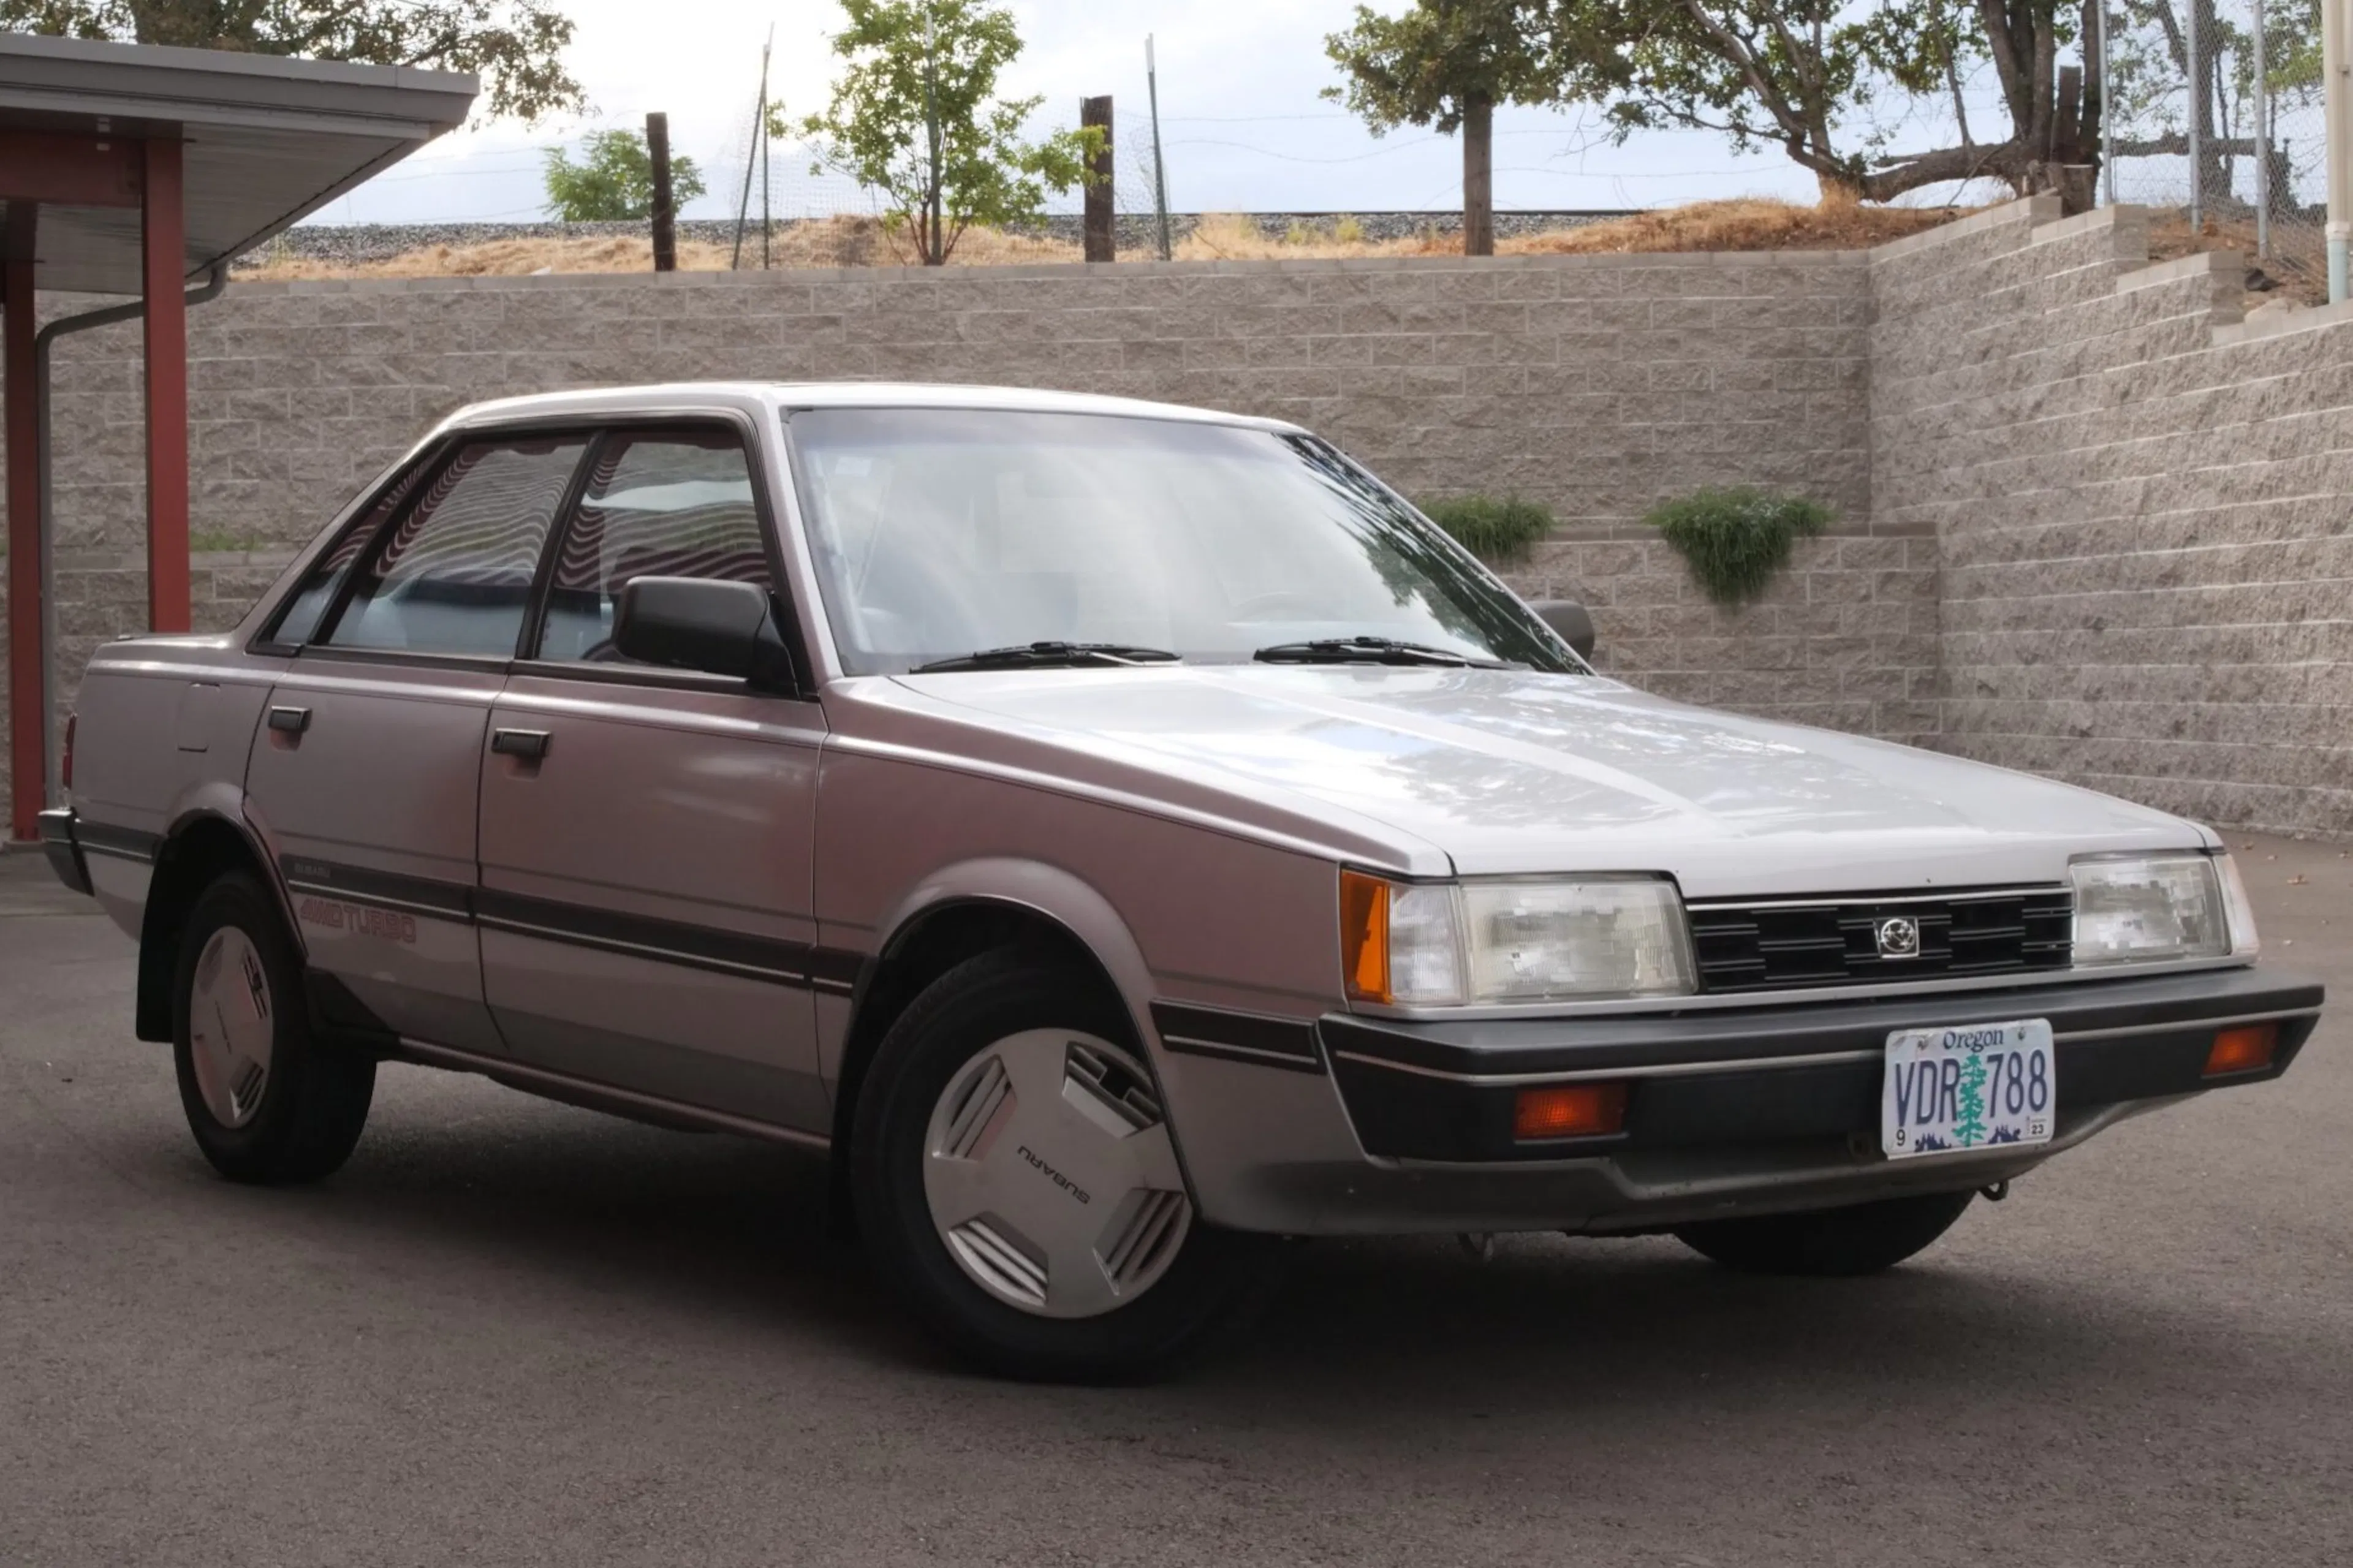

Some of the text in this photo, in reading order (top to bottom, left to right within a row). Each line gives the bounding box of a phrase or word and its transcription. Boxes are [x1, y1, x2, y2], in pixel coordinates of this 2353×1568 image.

[1942, 1029, 2004, 1053] Oregon
[1895, 1048, 2048, 1127] VDR 788
[1896, 1129, 1906, 1146] 9
[2031, 1124, 2044, 1135] 23
[1017, 1145, 1091, 1205] SUBARU
